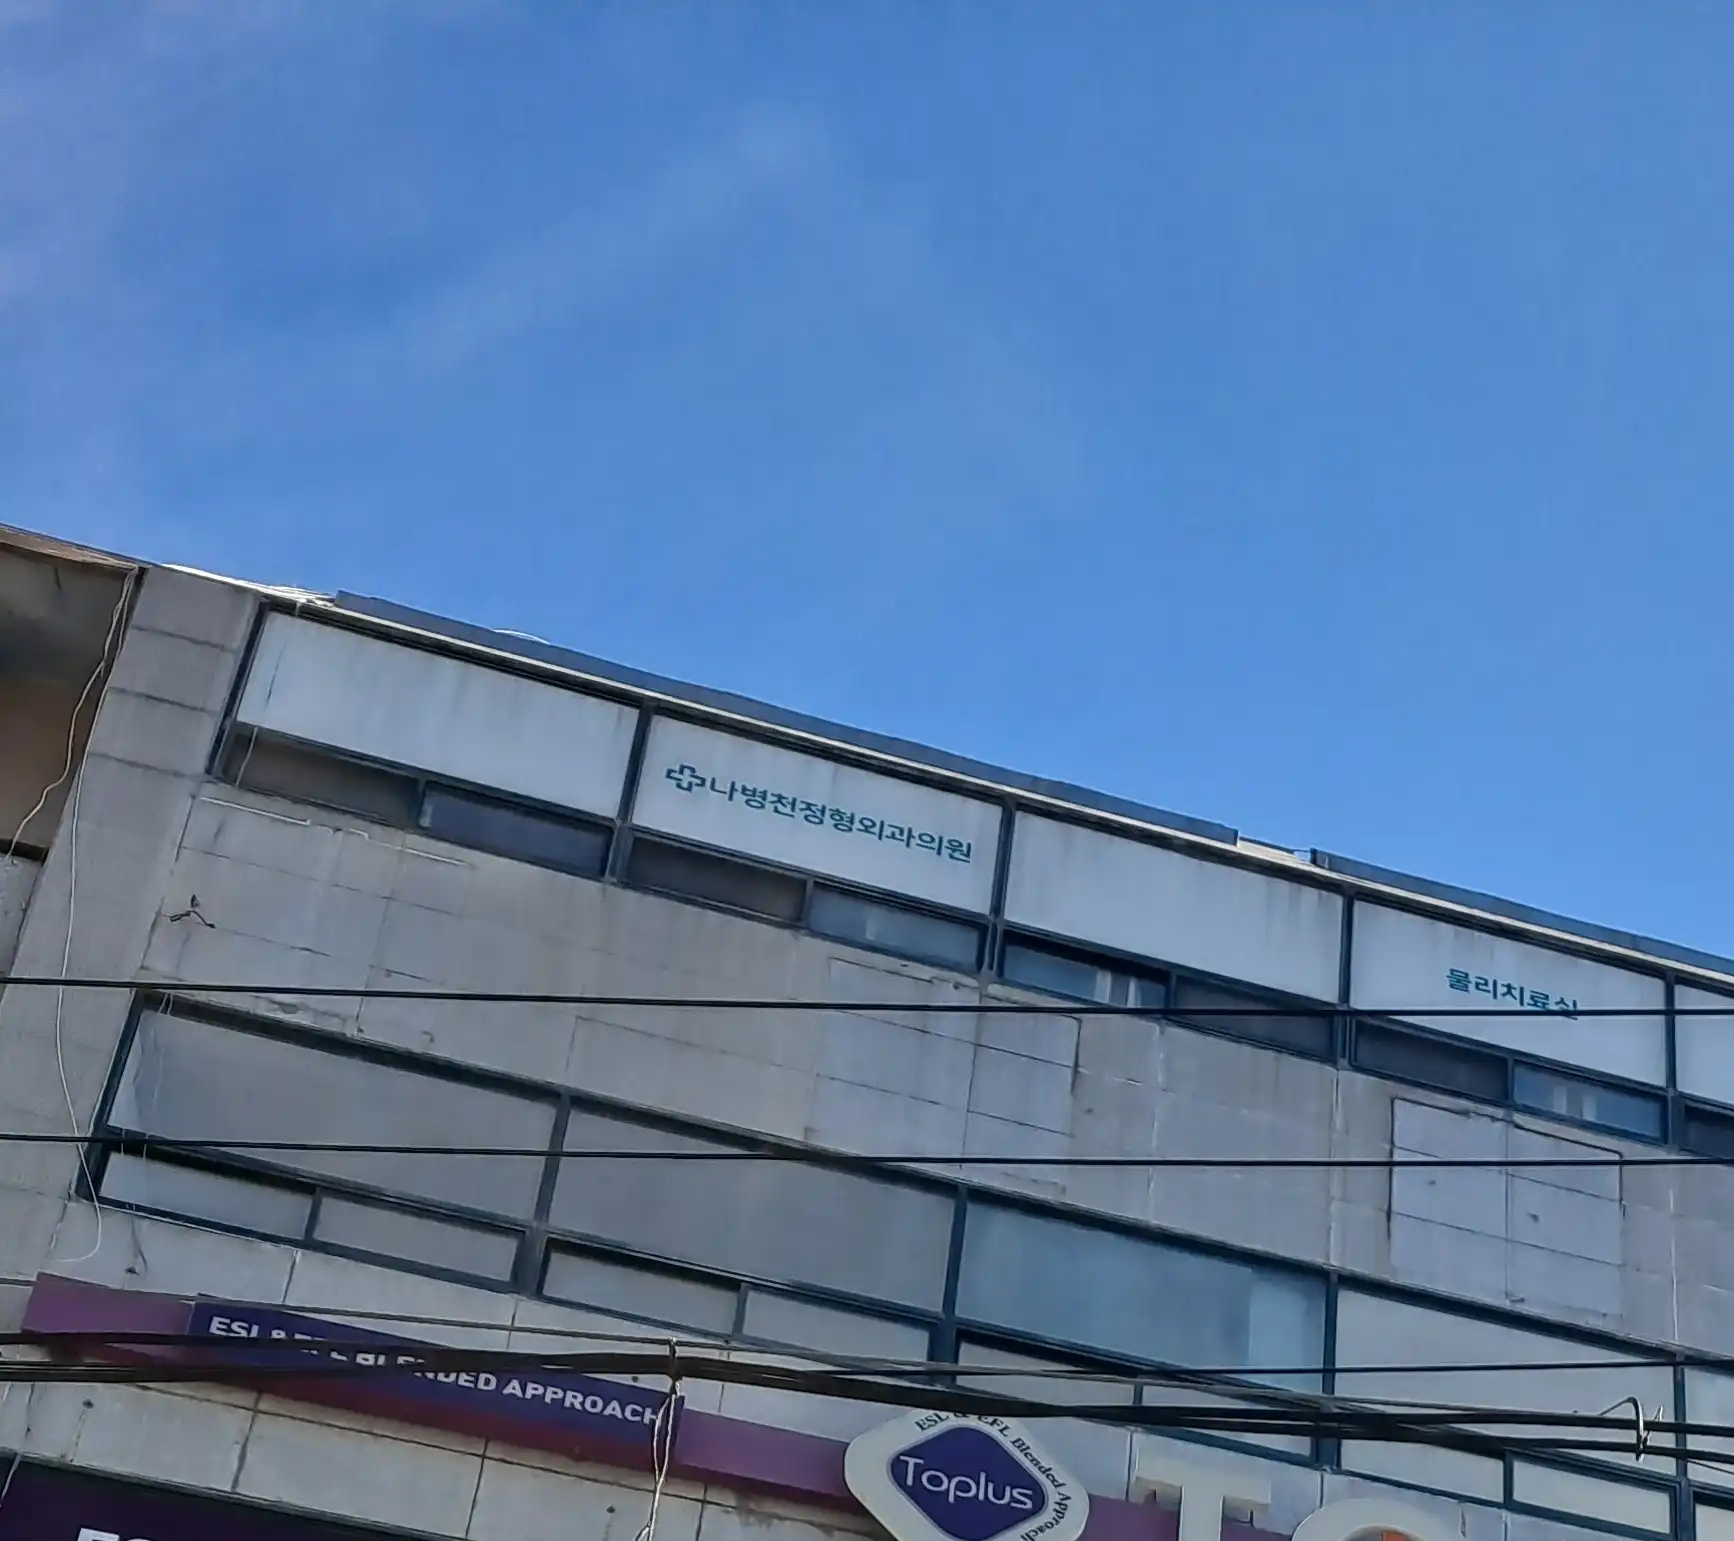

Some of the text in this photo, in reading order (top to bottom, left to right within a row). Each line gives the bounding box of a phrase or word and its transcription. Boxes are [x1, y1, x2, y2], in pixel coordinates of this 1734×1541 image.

[708, 773, 973, 865] 나병천정형외과의원
[1446, 968, 1579, 1021] 물리치료실
[502, 1378, 660, 1426] APPROACH
[900, 1456, 1034, 1511] Toplus
[1010, 1436, 1067, 1490] Blended
